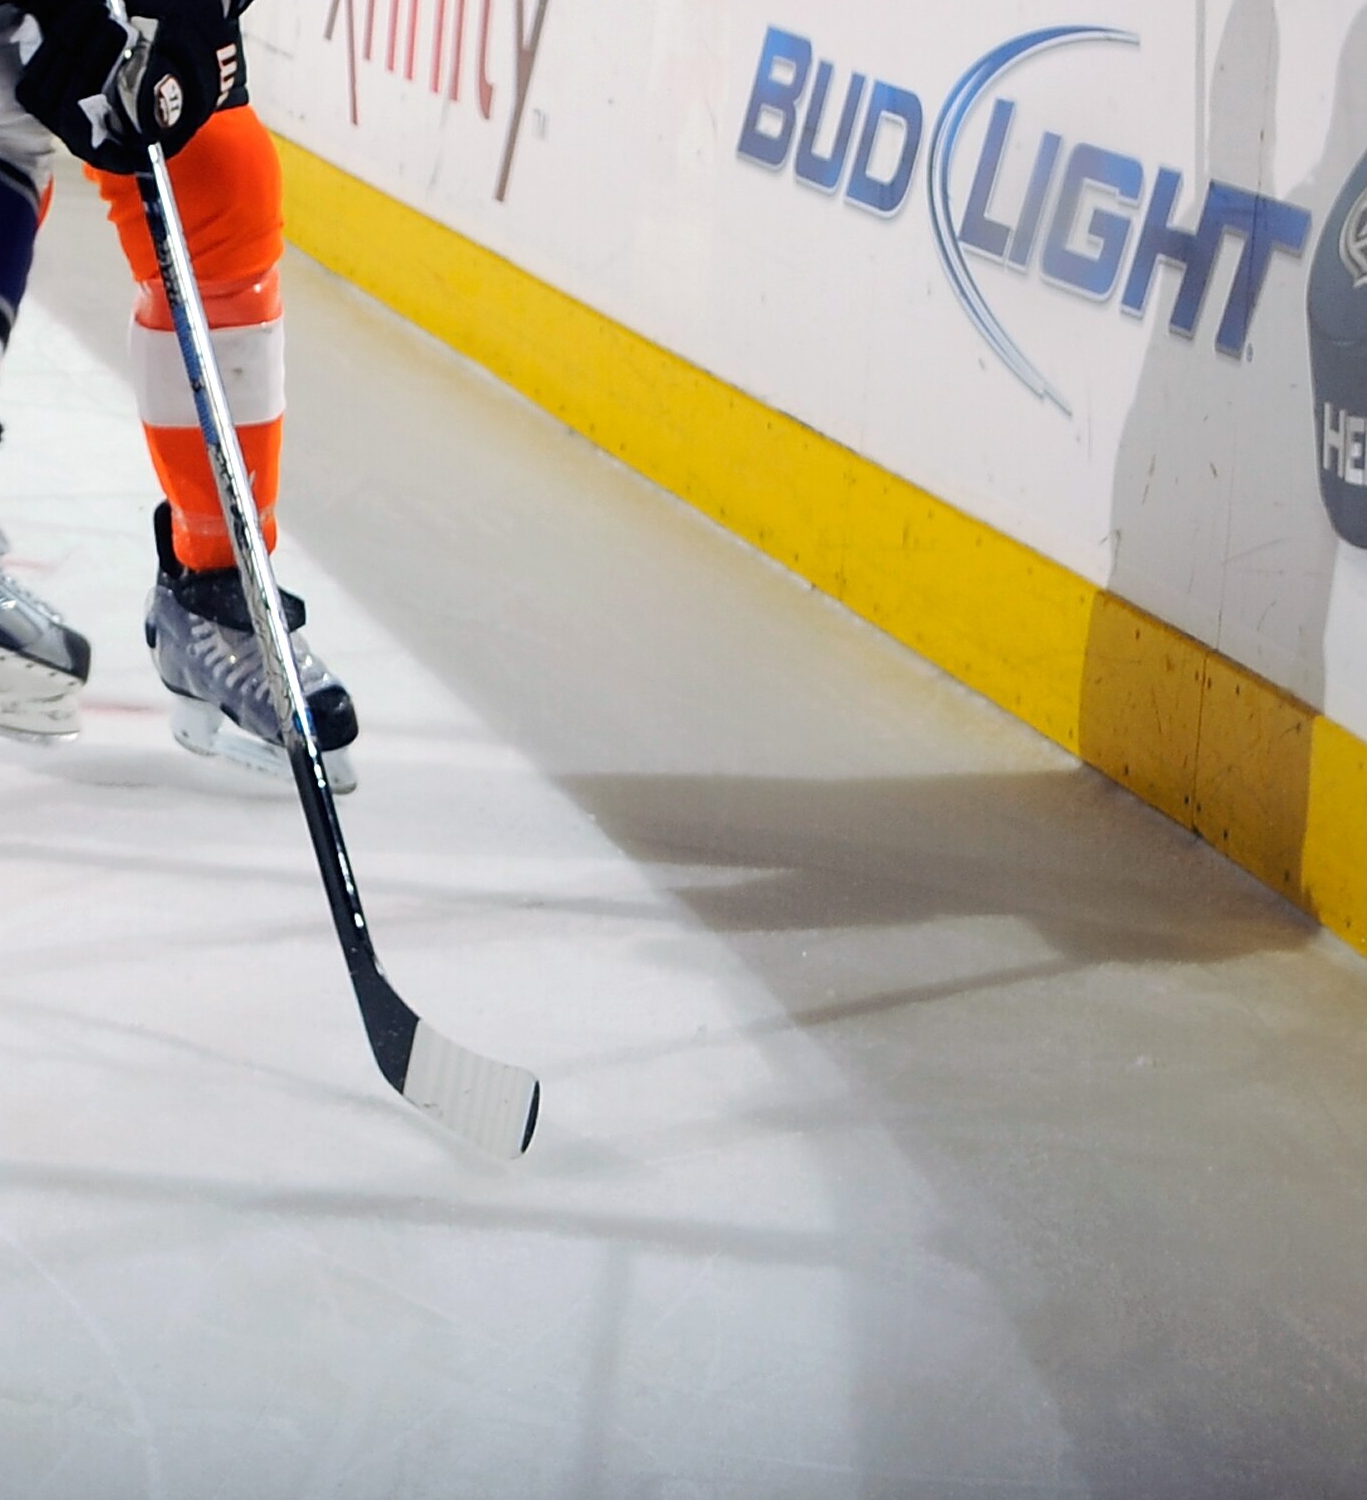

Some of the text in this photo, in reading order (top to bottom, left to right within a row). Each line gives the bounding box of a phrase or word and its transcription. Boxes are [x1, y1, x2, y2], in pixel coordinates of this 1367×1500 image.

[736, 26, 1313, 360] BUD LIGHT
[1323, 401, 1367, 487] HE
